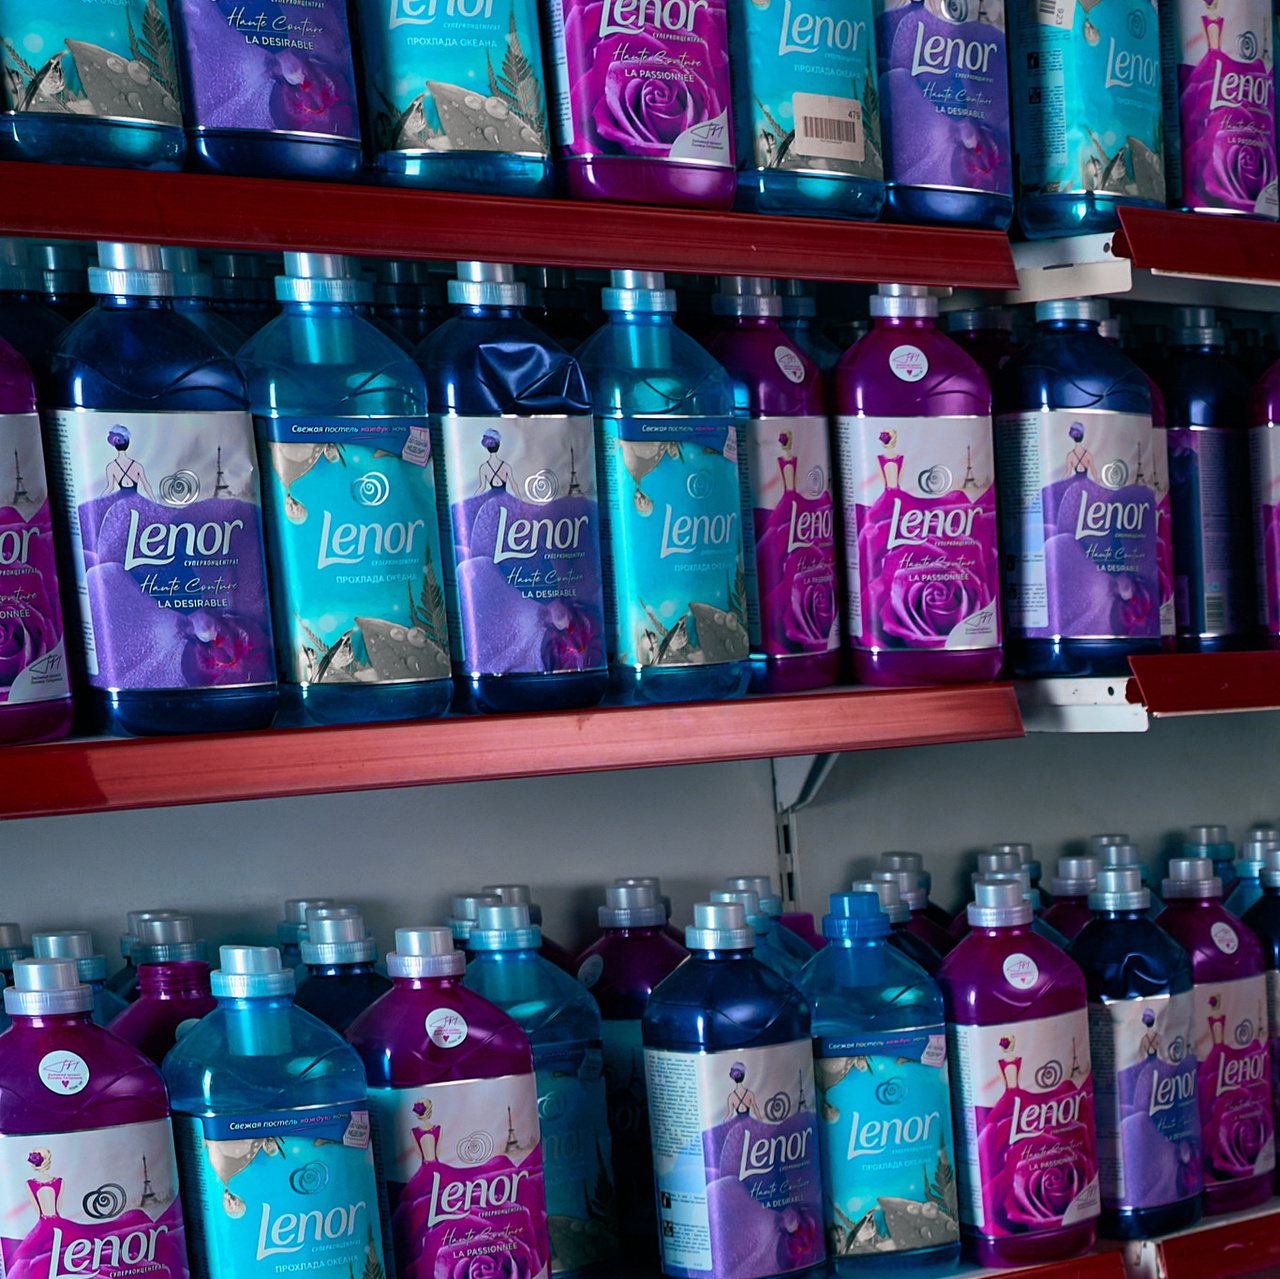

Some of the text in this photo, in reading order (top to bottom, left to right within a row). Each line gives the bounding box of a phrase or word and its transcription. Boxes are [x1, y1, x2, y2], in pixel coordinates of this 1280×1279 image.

[599, 0, 708, 37] Lenor
[779, 0, 866, 56] Lenor
[262, 37, 314, 50] DESIRABLE
[460, 38, 497, 48] ОКЕАНА
[911, 22, 997, 76] Lenor
[1105, 37, 1160, 88] Lenor
[625, 69, 637, 78] LA
[794, 64, 834, 76] ПРОХЛАДА
[1210, 60, 1272, 110] Lenor
[936, 106, 985, 119] LA DESIRABLE
[292, 424, 358, 434] Свежая постель
[493, 507, 589, 564] Lenor
[660, 504, 736, 559] Lenor
[886, 498, 983, 549] Lenor
[1074, 491, 1149, 541] Lenor
[124, 510, 243, 571] Lenor
[317, 510, 425, 570] Lenor
[141, 574, 180, 594] Haute
[336, 575, 384, 584] ПРОХЛАДА
[1107, 564, 1139, 573] DESIRABLE
[175, 599, 228, 608] DESIRABLE
[536, 588, 577, 598] DESIRABLE
[1149, 1069, 1197, 1117] Lenor
[1215, 1051, 1267, 1096] Lenor
[263, 1119, 298, 1129] постель
[847, 1111, 939, 1160] Lenor
[1009, 1090, 1087, 1144] Lenor
[738, 1127, 812, 1181] Lenor
[427, 1170, 528, 1228] Lenor
[256, 1201, 366, 1261] Lenor
[275, 1261, 325, 1273] ПРОХЛАДА
[452, 1250, 465, 1259] LA
